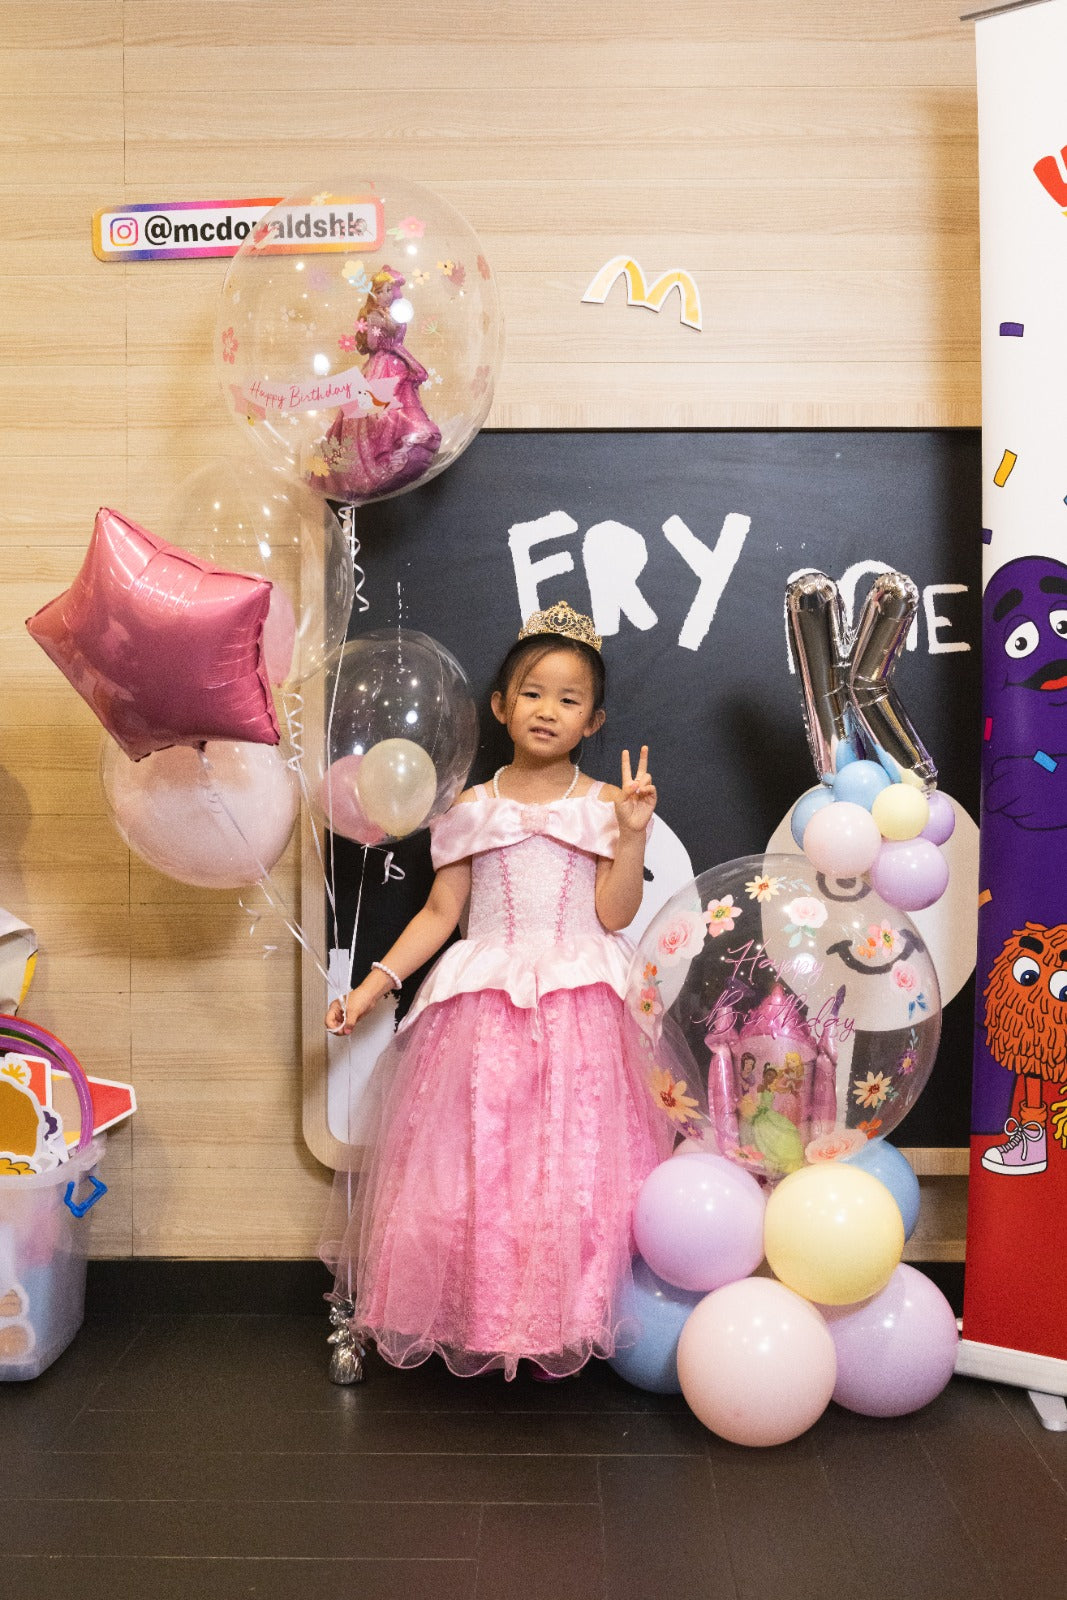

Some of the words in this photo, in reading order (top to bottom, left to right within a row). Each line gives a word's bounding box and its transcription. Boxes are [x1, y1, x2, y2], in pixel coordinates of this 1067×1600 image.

[145, 212, 367, 245] @mcdoaldshk
[249, 381, 286, 410] Happy
[289, 382, 352, 408] Birthday
[507, 510, 752, 651] FRY
[724, 937, 824, 985] Happy
[691, 989, 856, 1042] Birthday
